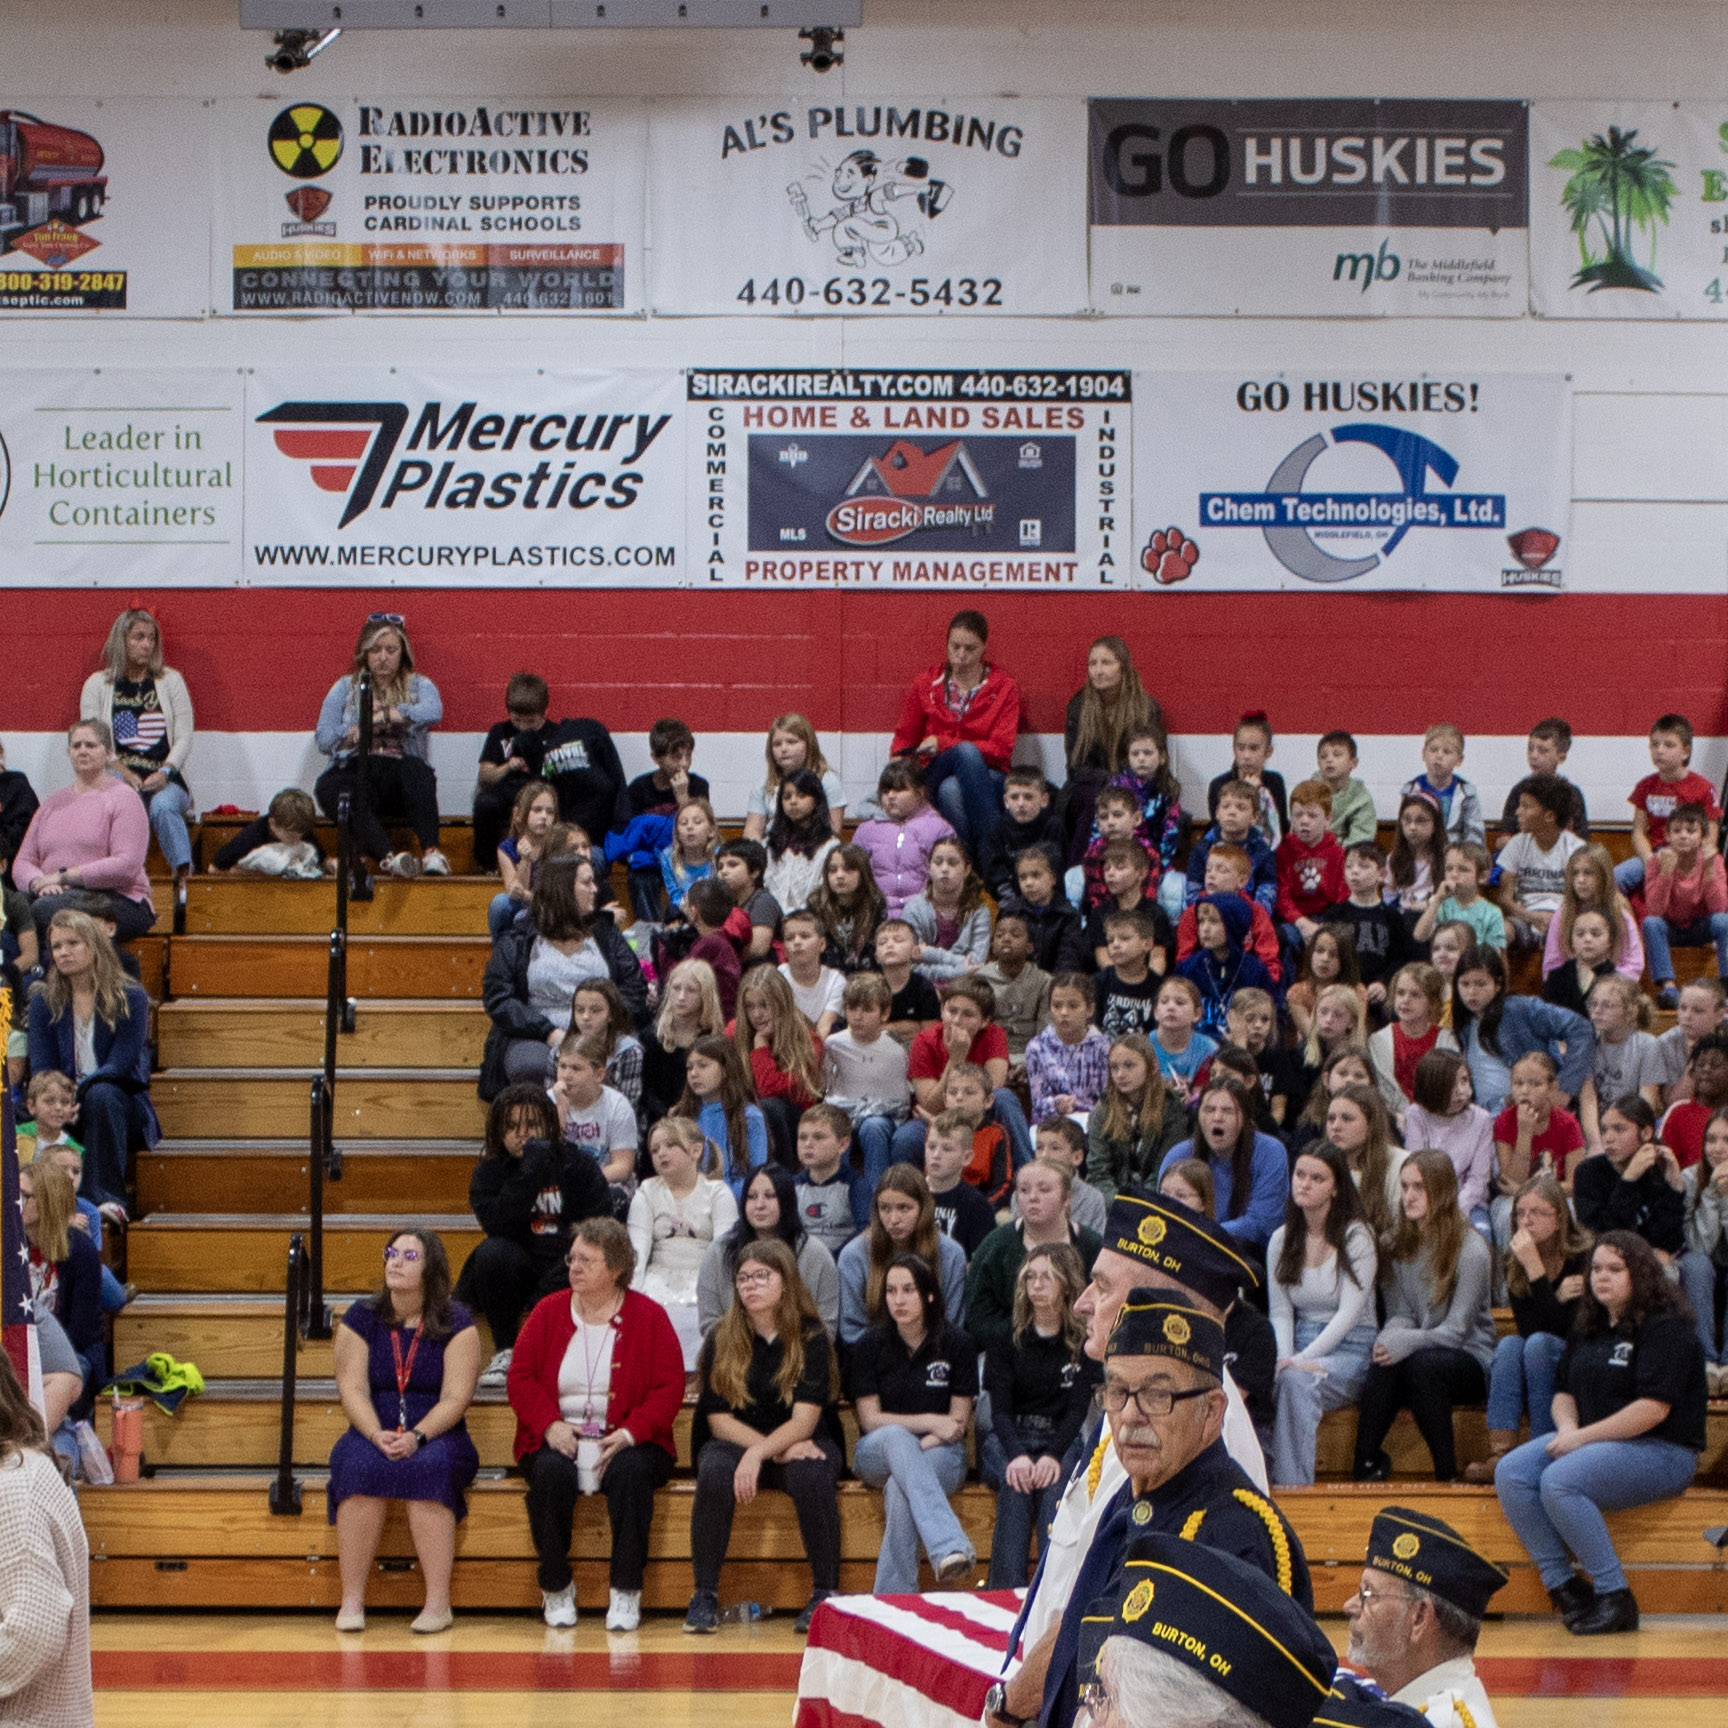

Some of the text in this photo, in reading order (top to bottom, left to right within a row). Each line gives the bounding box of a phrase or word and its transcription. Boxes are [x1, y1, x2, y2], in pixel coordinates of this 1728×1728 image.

[358, 106, 591, 138] RADIOACTIVE
[721, 105, 1024, 159] AL'S PLUMBING
[359, 144, 590, 176] ELECTRONICS
[1102, 123, 1506, 199] GO HUSKIES
[364, 195, 581, 211] PROUDLY SUPPORTS
[364, 216, 581, 232] CARDINAL SCHOOLS
[253, 250, 294, 261] AUDIO
[305, 249, 341, 261] VIDEO
[406, 249, 477, 261] NETWORKS
[509, 249, 601, 261] SURVEILLANCE
[242, 271, 616, 289] CONNECTING YOUR WORLD
[736, 276, 1003, 307] 440-632-5432
[242, 292, 481, 305] WWW.RADIOACTIVENOW.COM
[692, 374, 1124, 397] SIRACKIREALTY.COM 440-632-1904
[1236, 382, 1479, 412] GO HUSKIES!
[743, 406, 1086, 429] HOME & LAND SALES
[65, 424, 202, 451] Leader in
[406, 401, 673, 465] Mercury
[33, 462, 233, 489] Horticultural
[380, 459, 644, 509] Plastics
[706, 406, 726, 583] COMMERCIAL
[1098, 409, 1116, 585] INDUSTRIAL
[49, 500, 216, 526] Containers
[836, 505, 993, 533] Siracki Realty Ltd
[1207, 498, 1501, 526] Chem Technologies, Ltd.
[779, 528, 807, 541] MLS
[254, 545, 675, 567] WWW.MERCURYPLASTICS.COM
[745, 561, 1078, 582] PROPERTY MANAGEMENT
[1116, 1237, 1182, 1273] BURTON, OH
[1143, 1342, 1188, 1359] BURTON,
[1372, 1555, 1432, 1585] BURTON, OH
[1151, 1621, 1232, 1677] BURTON, OH
